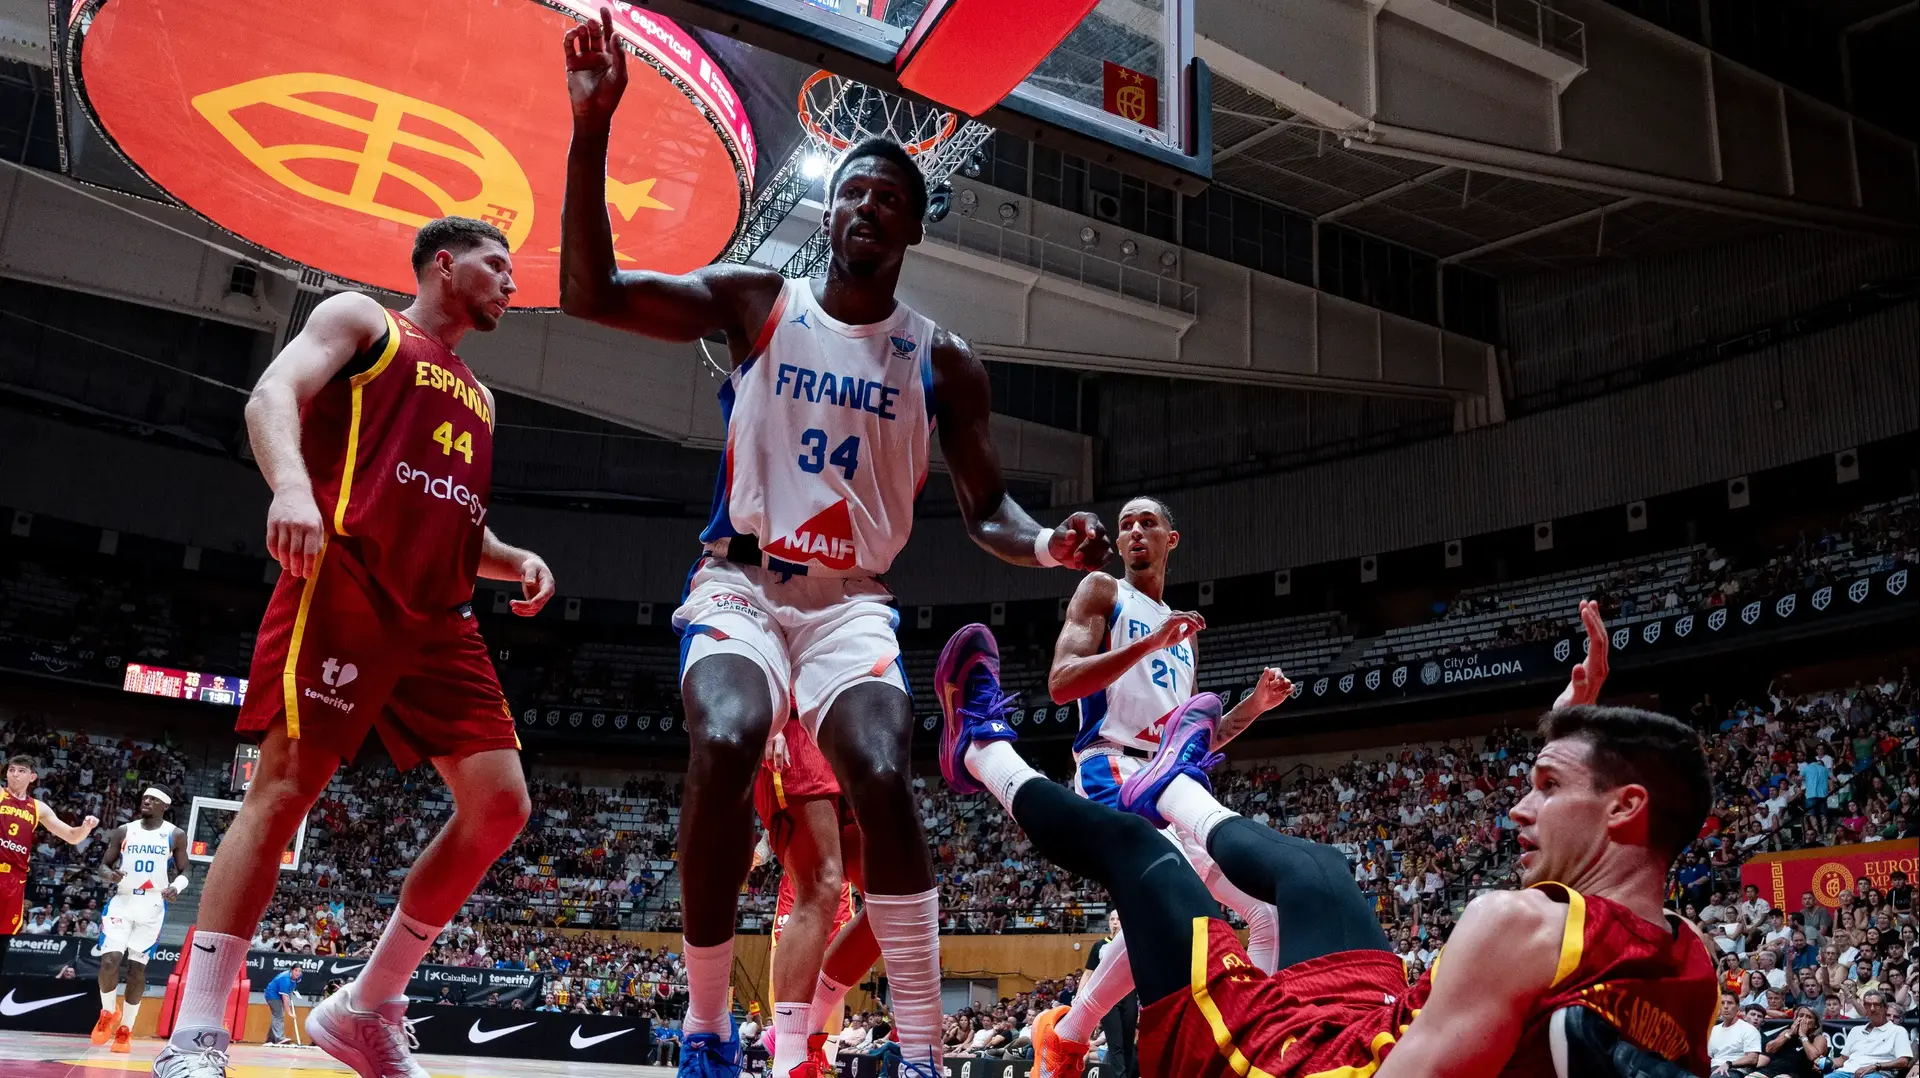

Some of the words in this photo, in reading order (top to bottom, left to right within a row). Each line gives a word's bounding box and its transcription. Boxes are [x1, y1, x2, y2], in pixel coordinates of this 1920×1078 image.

[481, 203, 518, 236] FE
[415, 361, 493, 435] ESPAÑA
[776, 363, 900, 420] FRANCE
[432, 420, 474, 464] 44
[798, 428, 861, 480] 34
[784, 530, 856, 561] MAIF
[1128, 618, 1192, 668] FRNCE
[1443, 658, 1465, 669] City
[1467, 653, 1478, 666] of
[1151, 658, 1177, 693] 21
[1444, 660, 1523, 684] BADALONA
[304, 687, 355, 714] tenerife!
[0, 805, 34, 824] ESPAÑA
[8, 823, 19, 835] 3
[0, 838, 28, 855] ndesa
[127, 844, 167, 856] FRANCE
[134, 859, 154, 873] 00
[9, 937, 68, 955] tenerife!
[273, 957, 324, 974] tenife!
[440, 972, 478, 984] CaixaBank
[489, 973, 535, 988] tenerife!
